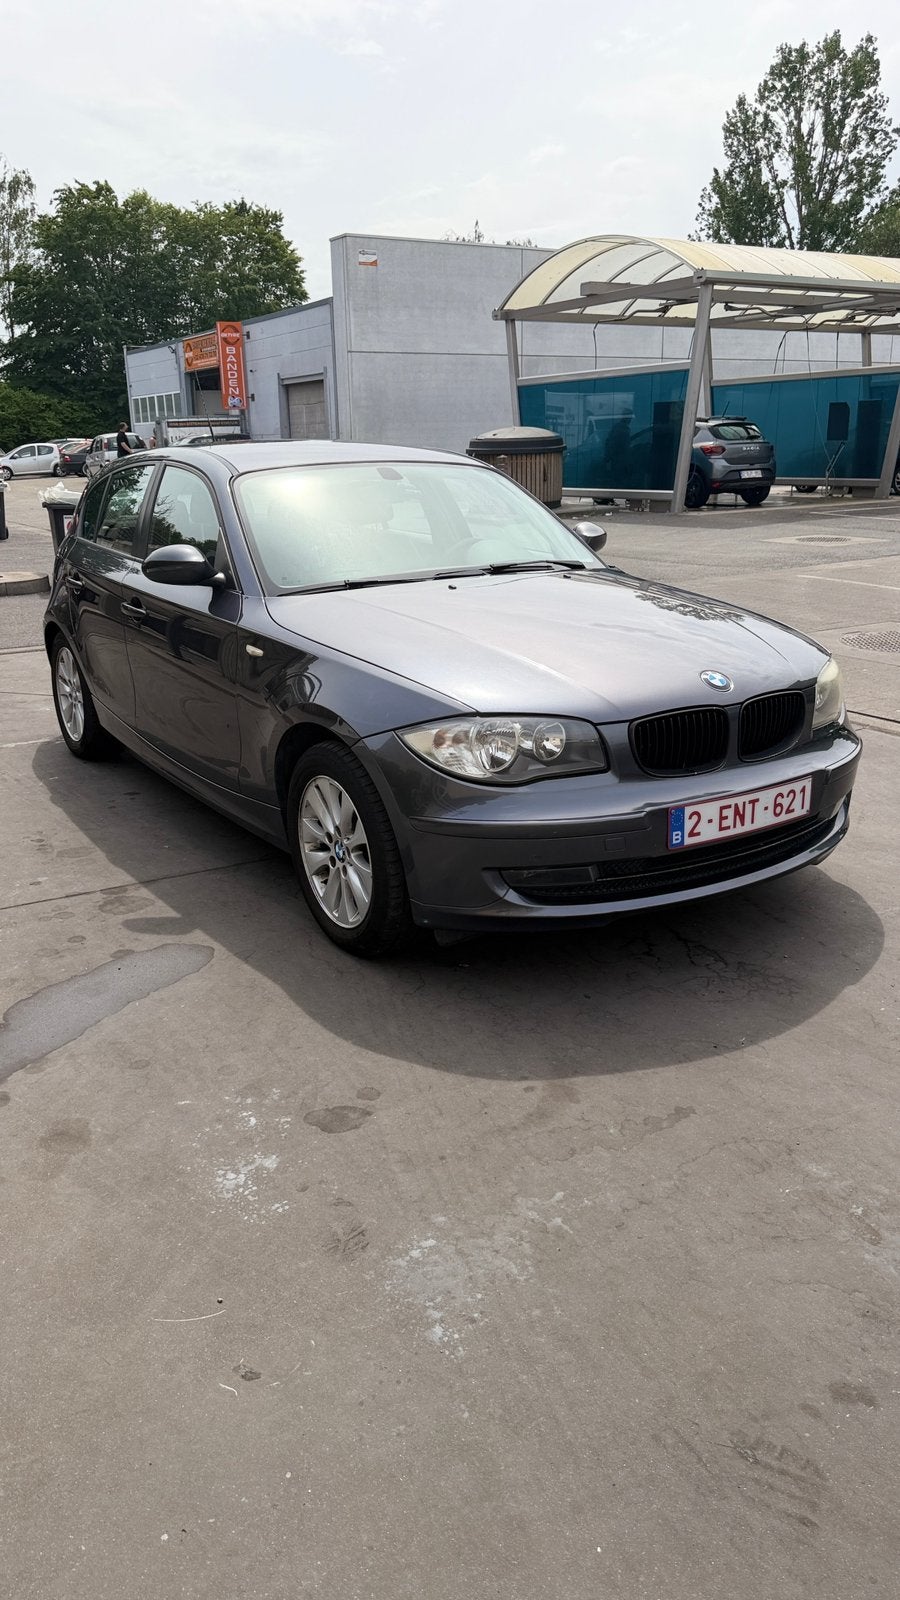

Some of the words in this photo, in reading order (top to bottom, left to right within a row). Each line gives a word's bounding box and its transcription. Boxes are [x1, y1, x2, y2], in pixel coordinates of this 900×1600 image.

[226, 346, 239, 395] BANDEN
[687, 785, 806, 838] 2-ENT-621
[672, 830, 682, 844] B
